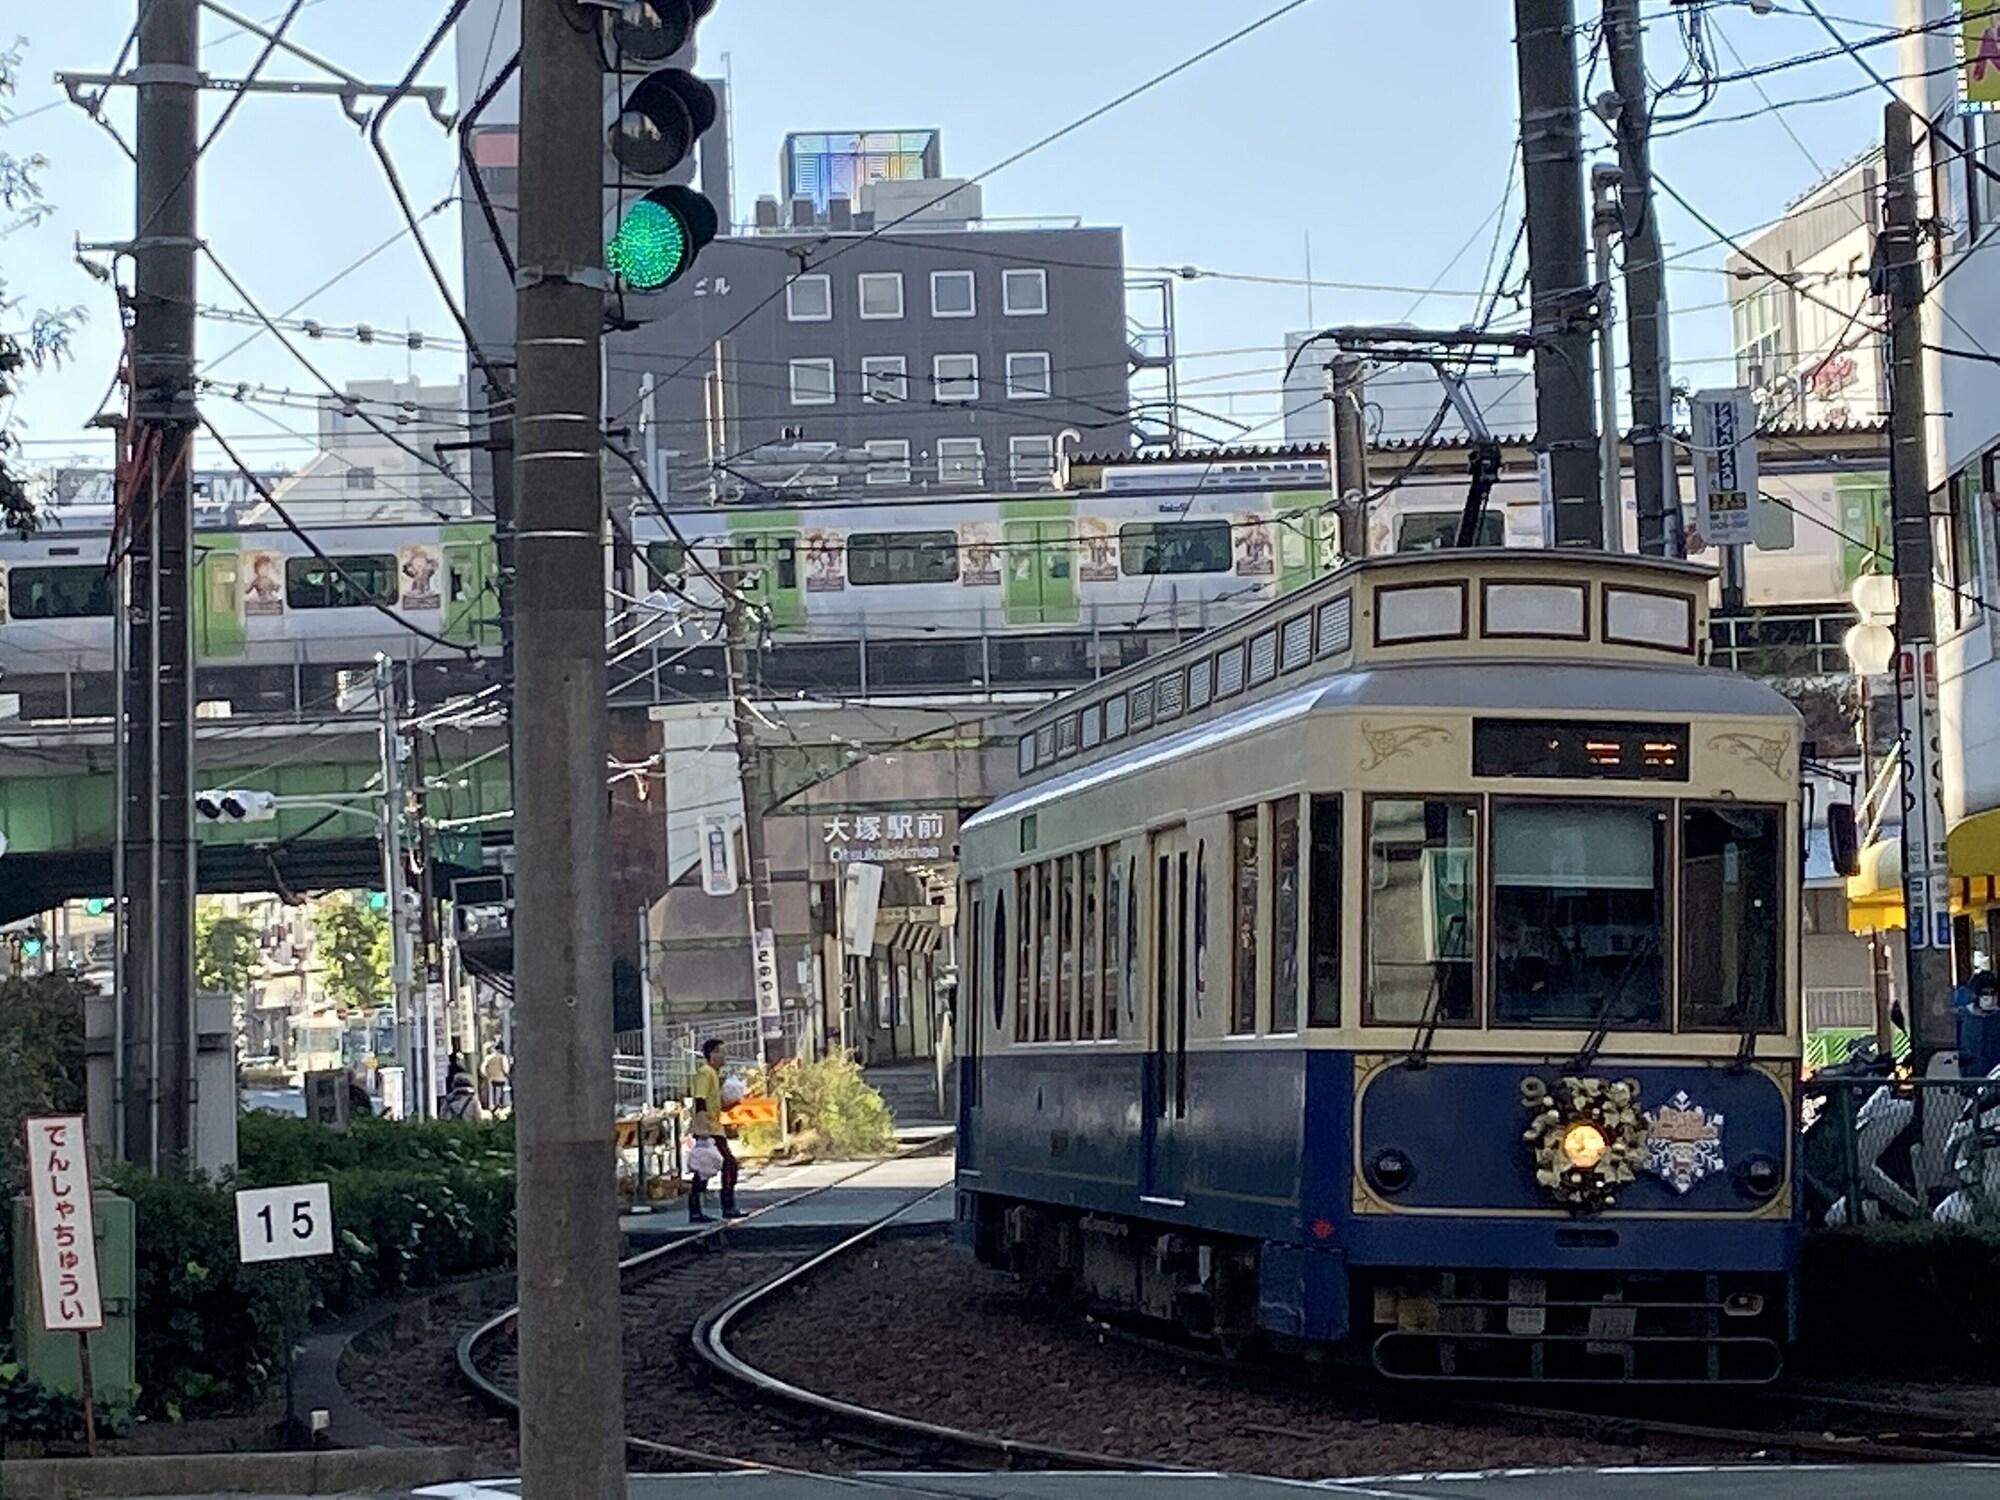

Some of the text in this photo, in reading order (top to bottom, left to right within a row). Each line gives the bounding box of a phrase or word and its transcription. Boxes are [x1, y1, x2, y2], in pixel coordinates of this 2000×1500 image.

[823, 813, 943, 842] 大塚駅前
[43, 1124, 85, 1321] でんしゃちゅうい
[257, 1200, 314, 1243] 15
